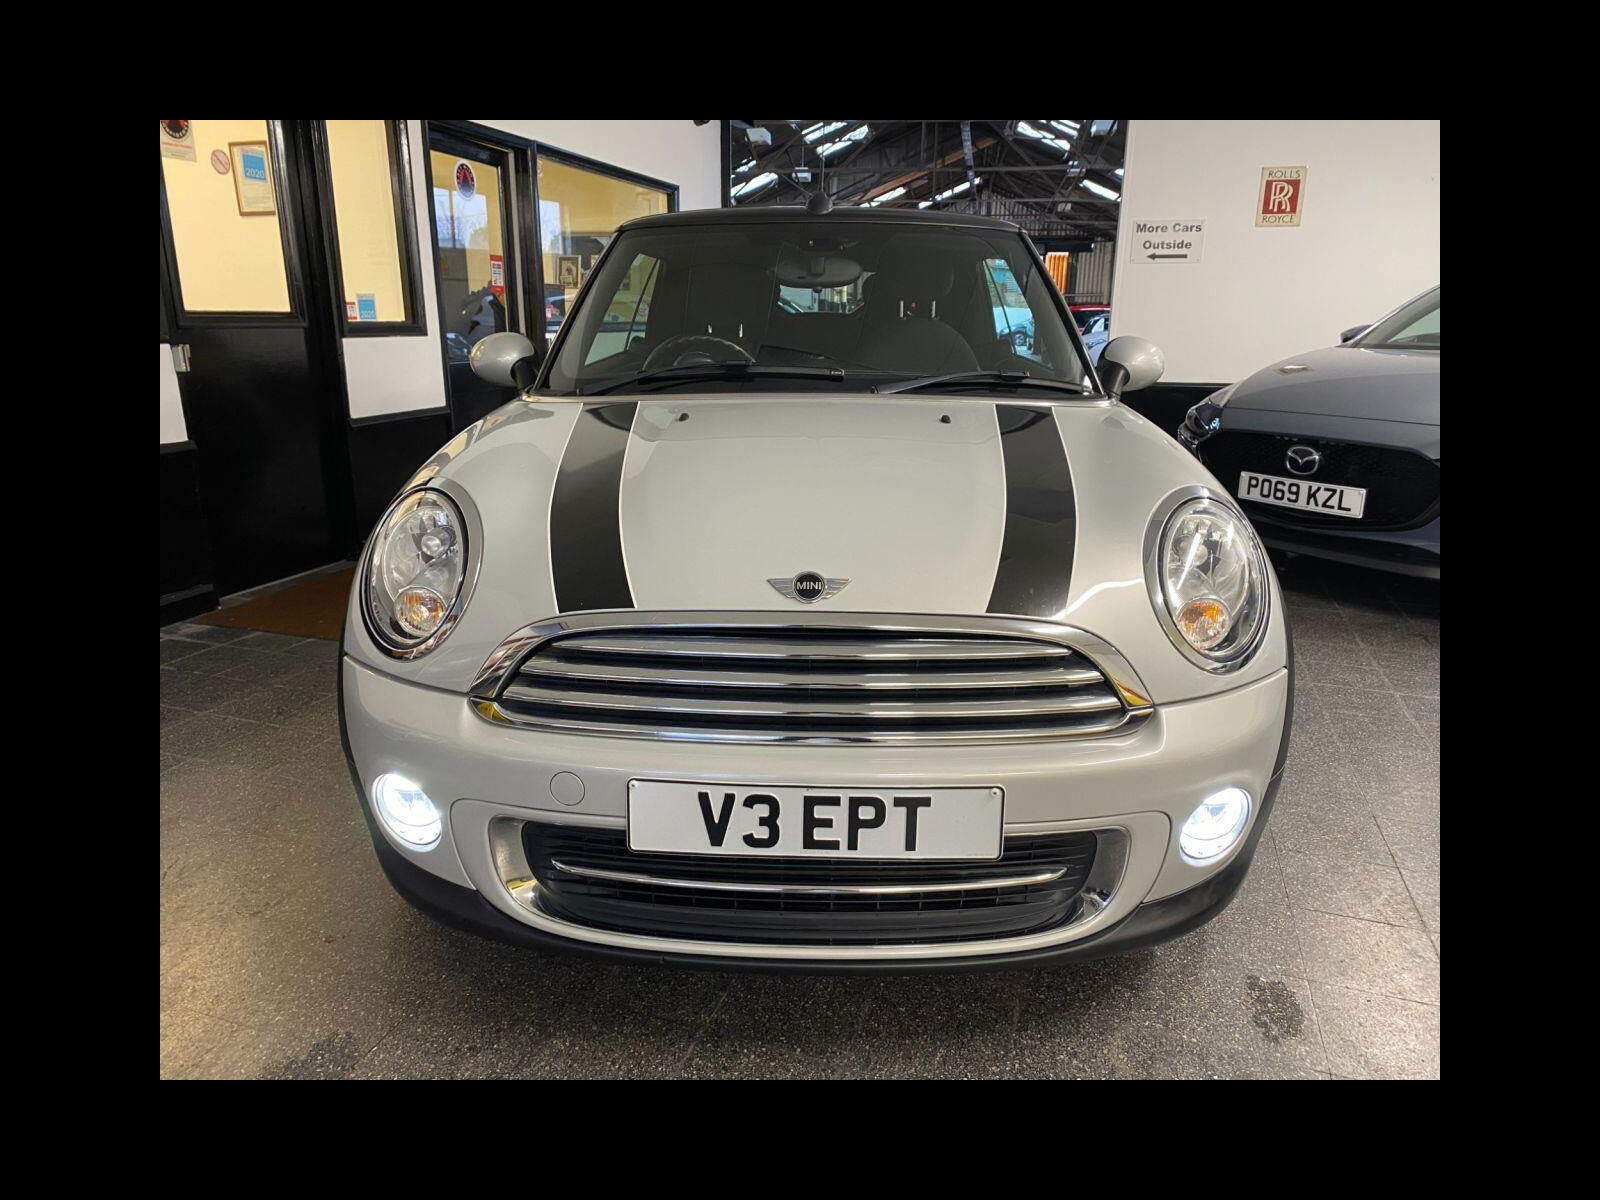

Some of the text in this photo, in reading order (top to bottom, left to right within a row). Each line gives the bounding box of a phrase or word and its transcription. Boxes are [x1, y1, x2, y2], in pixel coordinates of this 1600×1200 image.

[245, 167, 265, 179] 2020
[1267, 169, 1302, 179] ROLLS
[1262, 215, 1295, 224] ROYCE
[1136, 222, 1203, 233] More Cars
[1142, 240, 1192, 250] Outside
[1247, 476, 1351, 511] PO69 KZL
[796, 581, 822, 590] MINI
[697, 791, 931, 852] V3 EPT
